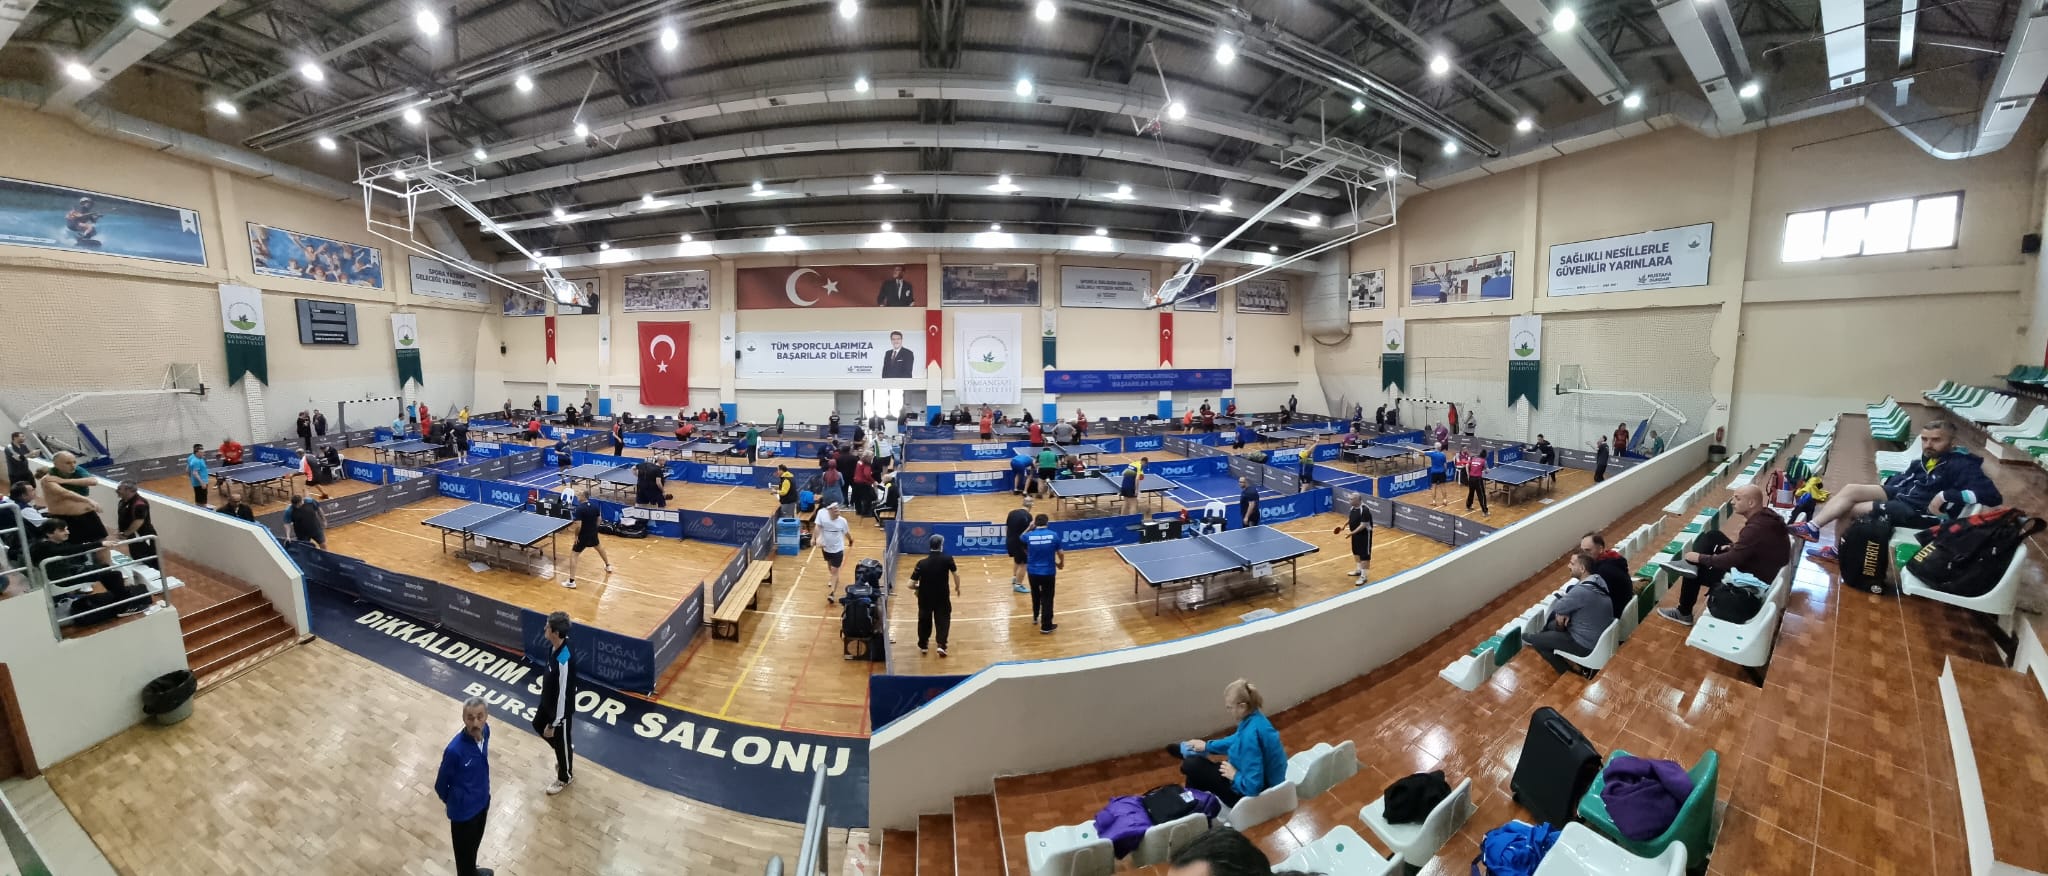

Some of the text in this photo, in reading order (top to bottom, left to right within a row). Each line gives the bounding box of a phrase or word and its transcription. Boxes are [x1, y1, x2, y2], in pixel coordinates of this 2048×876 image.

[1560, 242, 1669, 266] SAĞLIKLI NESİLLERLE
[1555, 255, 1673, 277] GÜVENİLİR YARINLARA
[771, 341, 874, 350] TÜM SPORCULARIMIZA
[776, 351, 868, 361] BAŞARILAR DİLERİM
[1162, 465, 1194, 475] JOOLA
[491, 489, 521, 504] JOOLA
[1062, 526, 1114, 543] JOOLA
[1862, 540, 1880, 577] BUTTERFLY
[597, 640, 640, 661] DOĞAL
[597, 653, 646, 673] KAYNAK
[527, 674, 626, 726] SOR
[633, 712, 851, 777] SALONU
